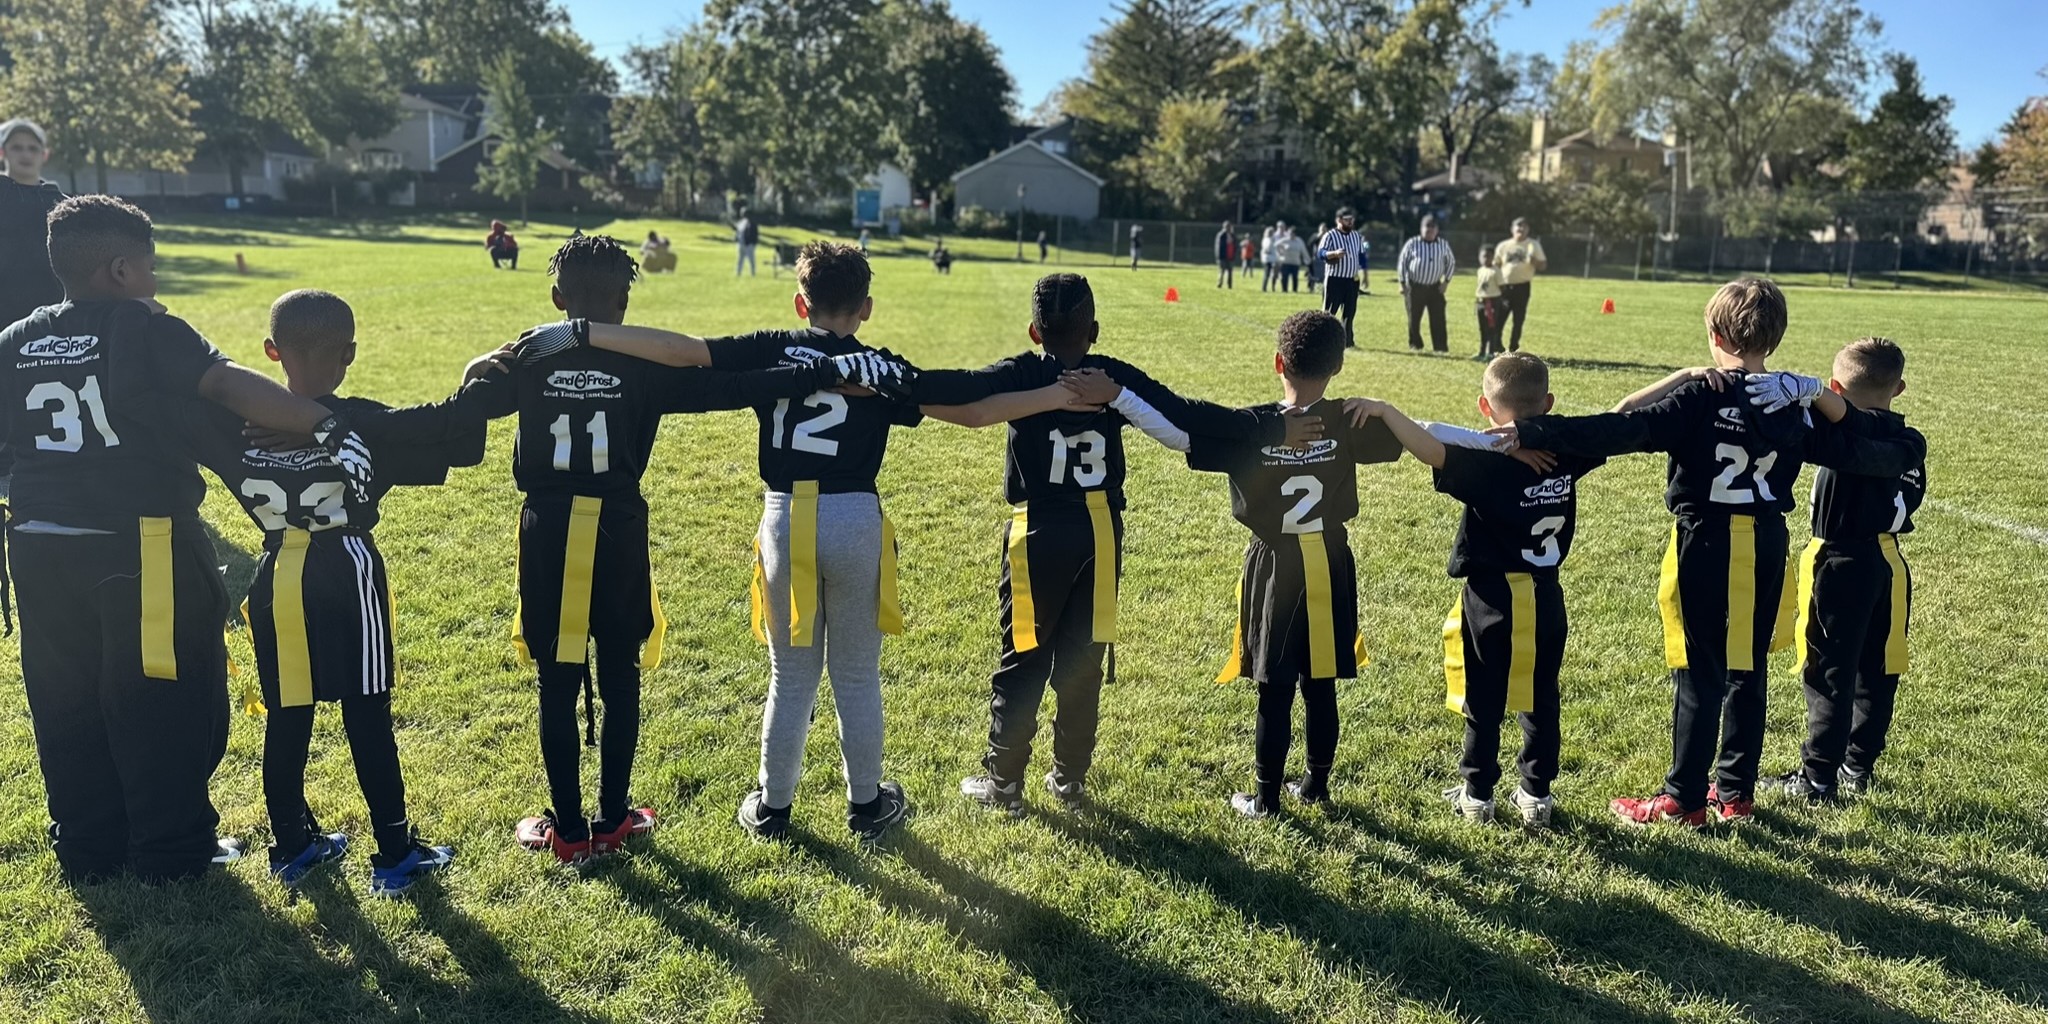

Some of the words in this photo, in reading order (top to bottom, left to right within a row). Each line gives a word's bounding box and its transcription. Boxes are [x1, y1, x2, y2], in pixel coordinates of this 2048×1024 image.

[16, 360, 38, 369] Great
[553, 375, 574, 386] and
[26, 375, 120, 452] 31
[549, 411, 609, 474] 11
[772, 390, 849, 456] 12
[1049, 428, 1107, 487] 13
[1709, 442, 1778, 504] 21
[240, 477, 348, 532] 23
[1280, 475, 1324, 534] 2
[1520, 499, 1538, 507] Great
[1521, 515, 1566, 567] 3
